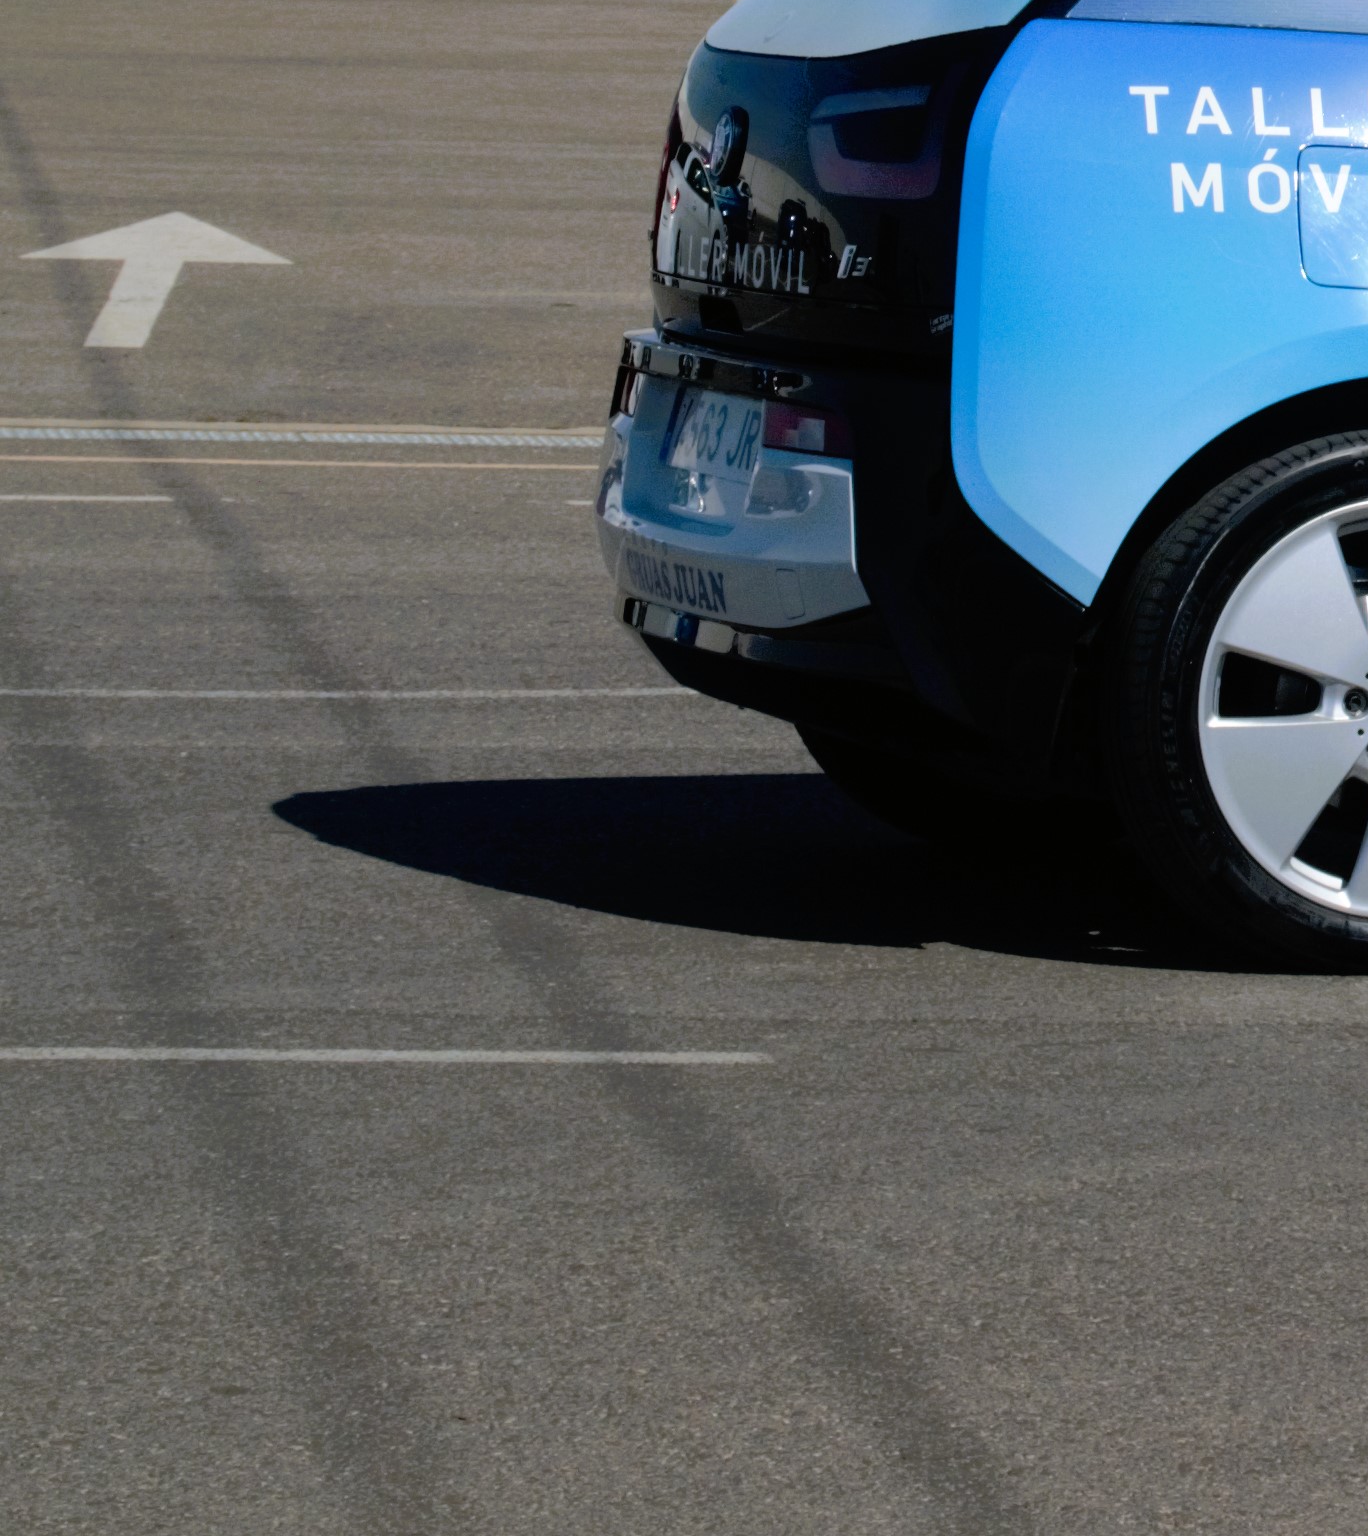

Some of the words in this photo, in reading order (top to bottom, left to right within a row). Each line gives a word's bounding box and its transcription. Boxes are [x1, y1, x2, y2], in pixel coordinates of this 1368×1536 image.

[733, 231, 810, 295] MÓVIL
[837, 244, 872, 279] i3
[726, 408, 763, 473] JR
[674, 563, 727, 615] JUAN
